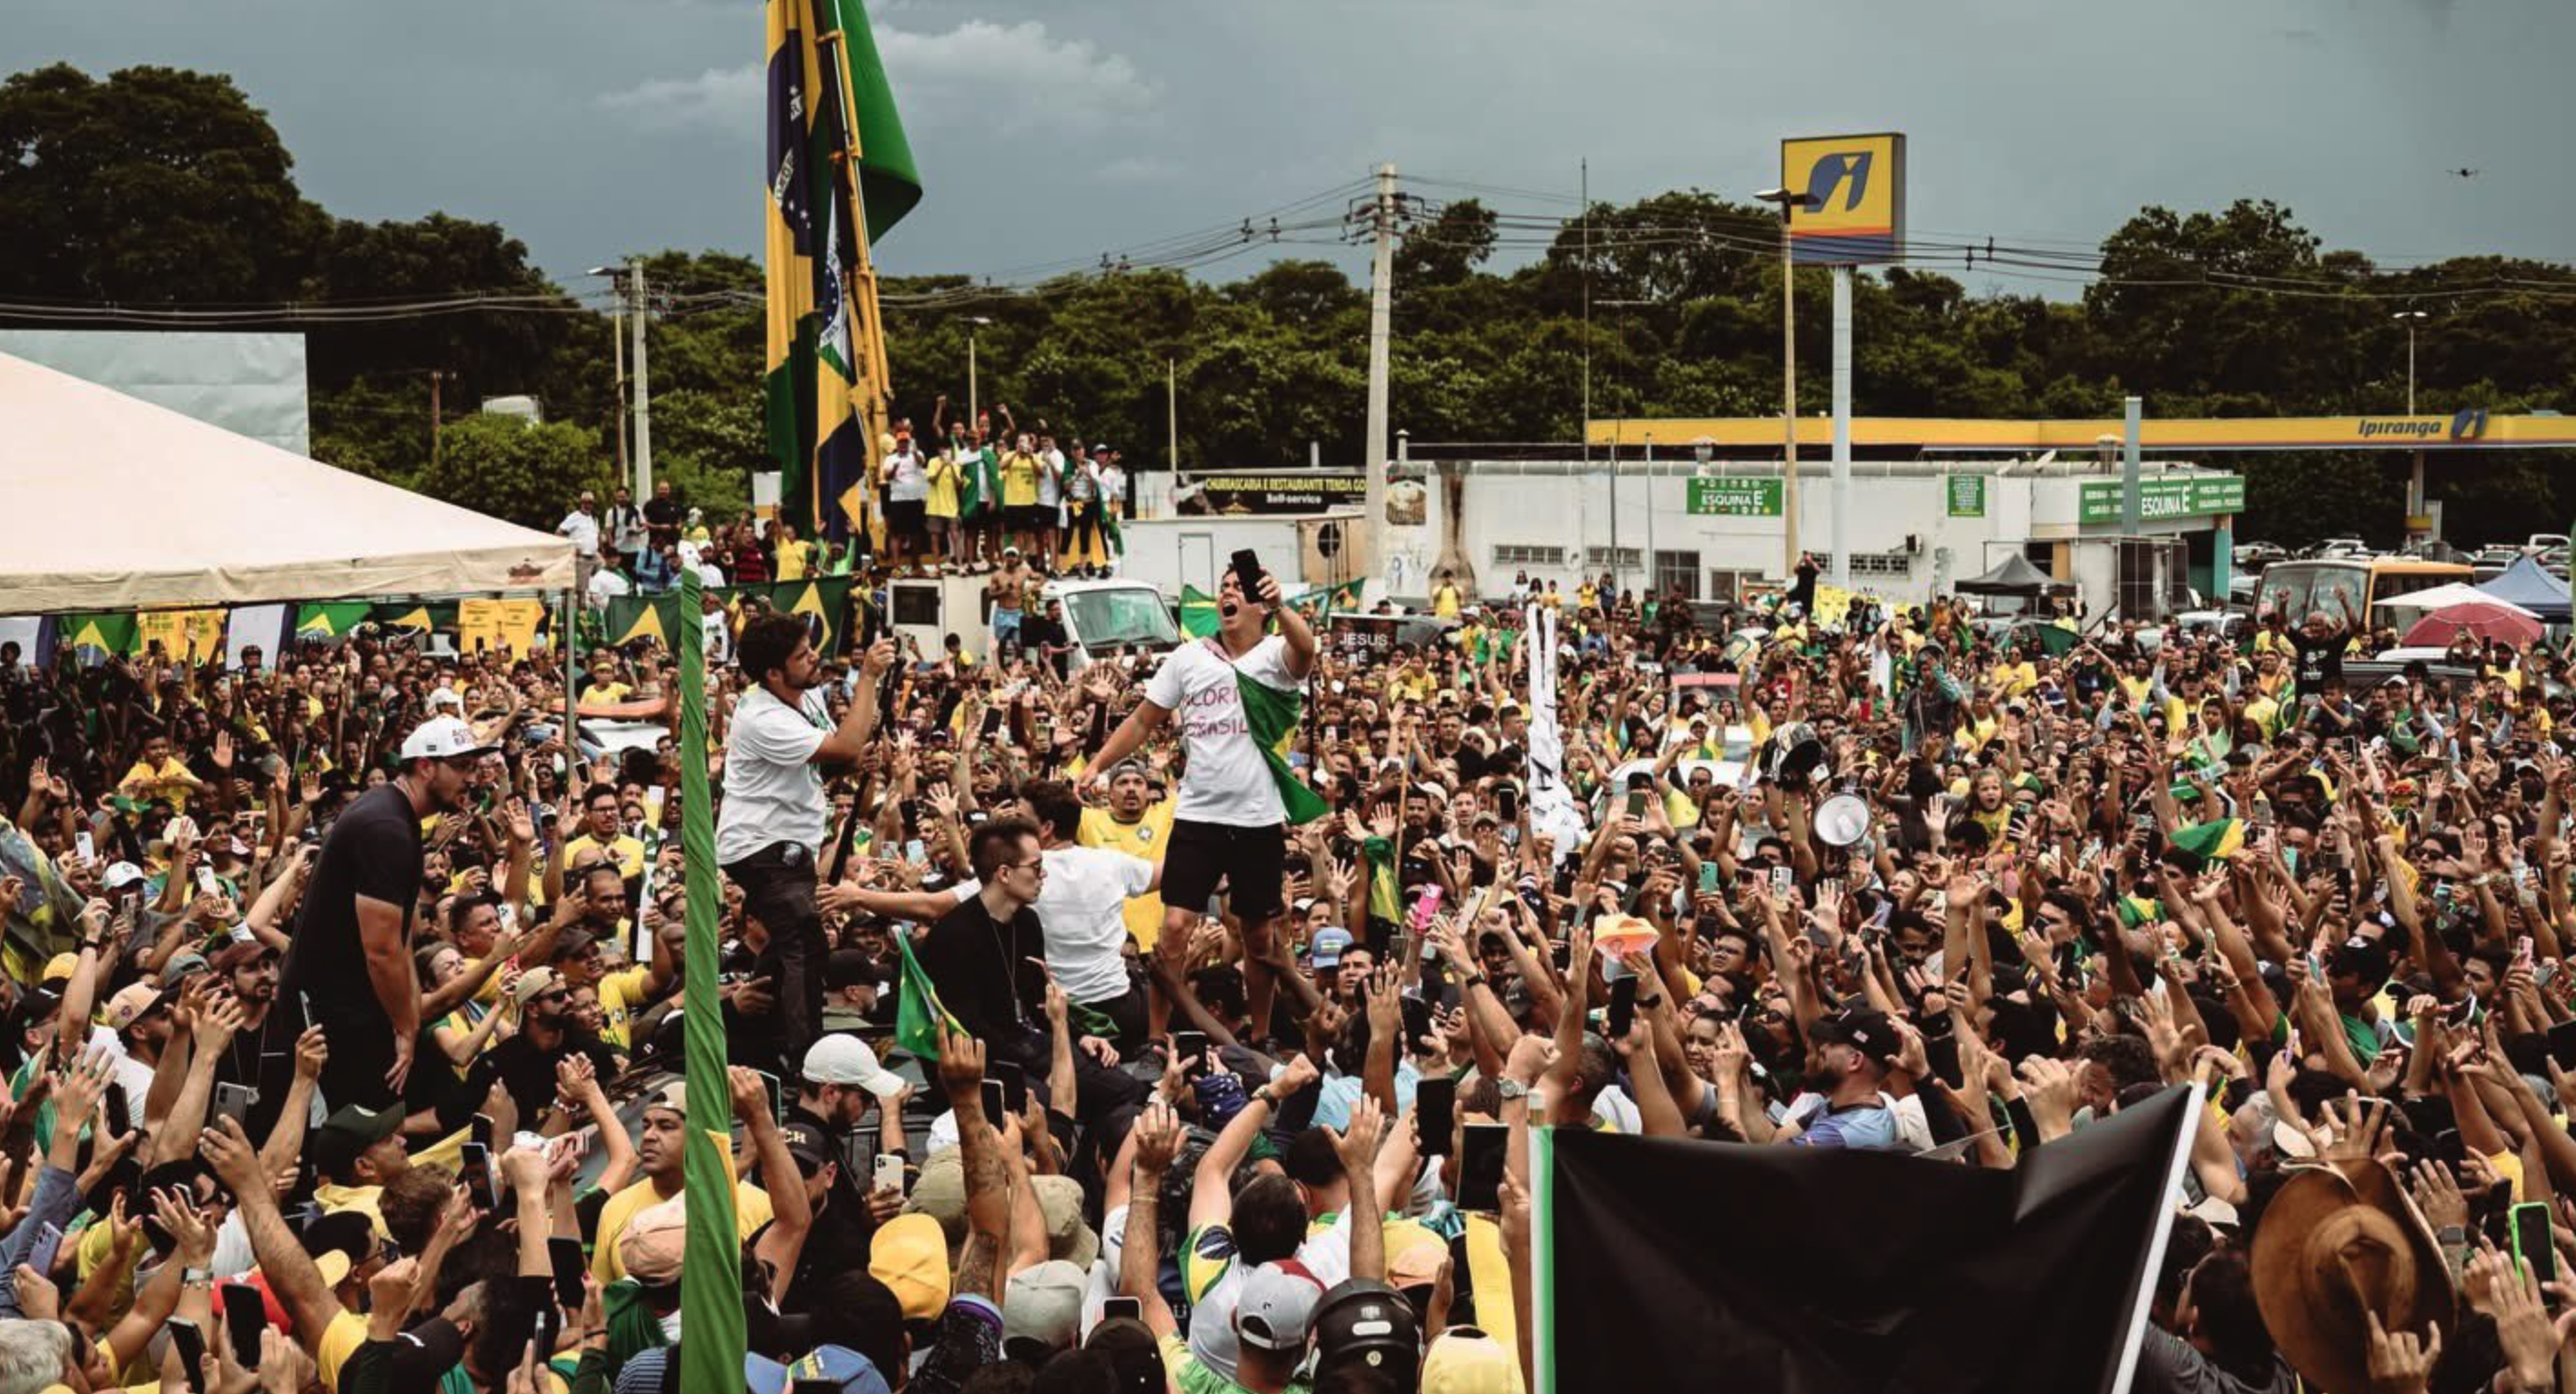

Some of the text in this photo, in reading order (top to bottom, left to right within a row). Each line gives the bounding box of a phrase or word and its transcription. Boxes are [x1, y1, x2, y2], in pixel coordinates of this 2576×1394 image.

[2358, 419, 2442, 438] Ipiranga
[1701, 494, 1751, 506] ESQUINA
[2141, 496, 2181, 516] ESQUINA
[1339, 632, 1388, 646] JESUS
